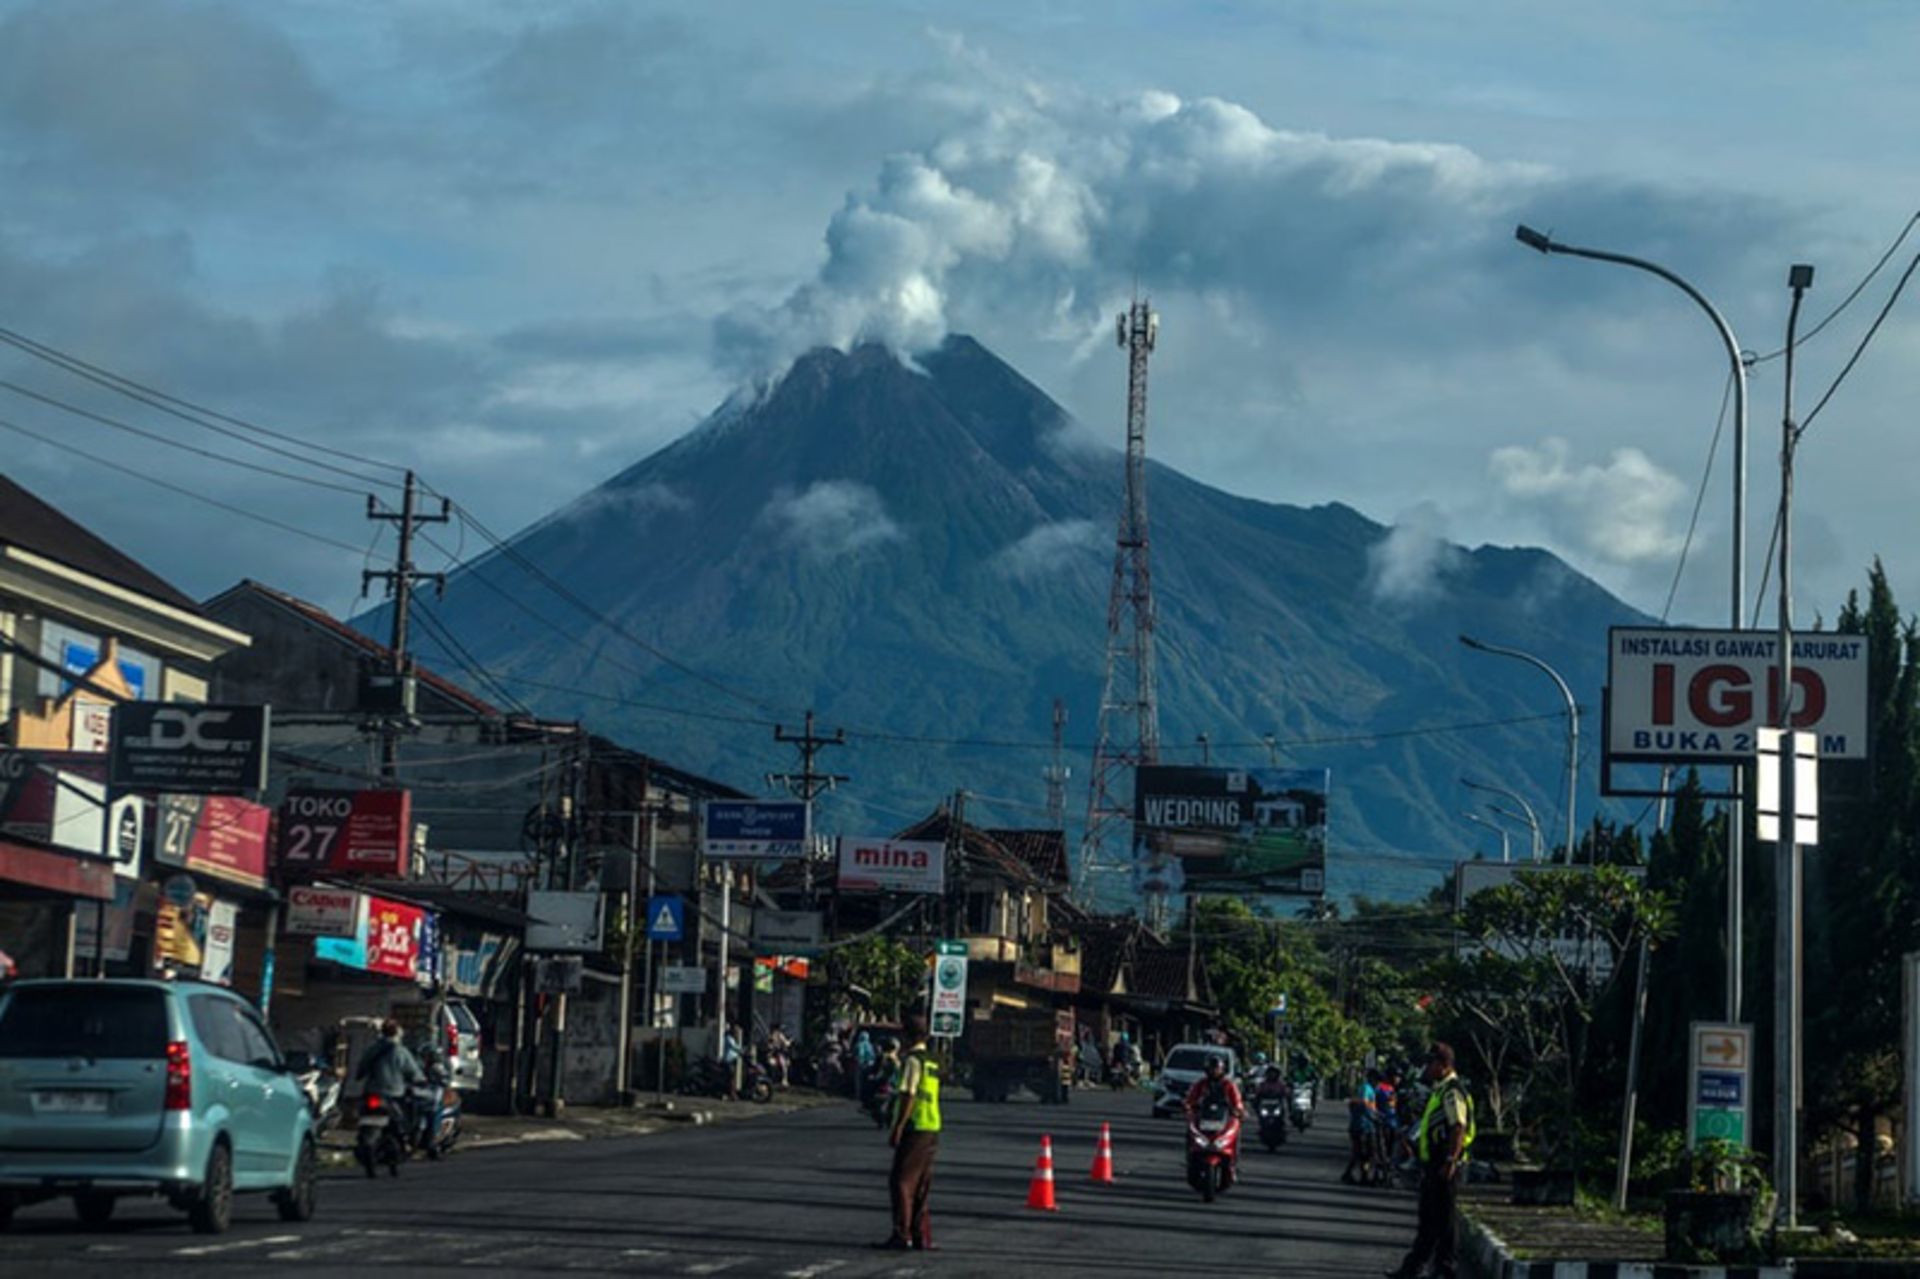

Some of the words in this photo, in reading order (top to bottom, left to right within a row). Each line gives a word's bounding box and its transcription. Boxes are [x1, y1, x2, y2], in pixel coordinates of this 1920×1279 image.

[1621, 638, 1710, 657] INSTALASI
[1716, 640, 1776, 659] GAWAT
[1791, 643, 1861, 660] ARURAT
[1652, 664, 1827, 728] IGD
[1634, 731, 1722, 750] BUKA
[1733, 733, 1758, 752] 2
[287, 796, 352, 817] TOKO
[1144, 799, 1241, 827] WEDDING
[162, 810, 192, 857] 27
[286, 825, 337, 861] 27
[855, 844, 928, 867] mina
[292, 891, 351, 908] Canon
